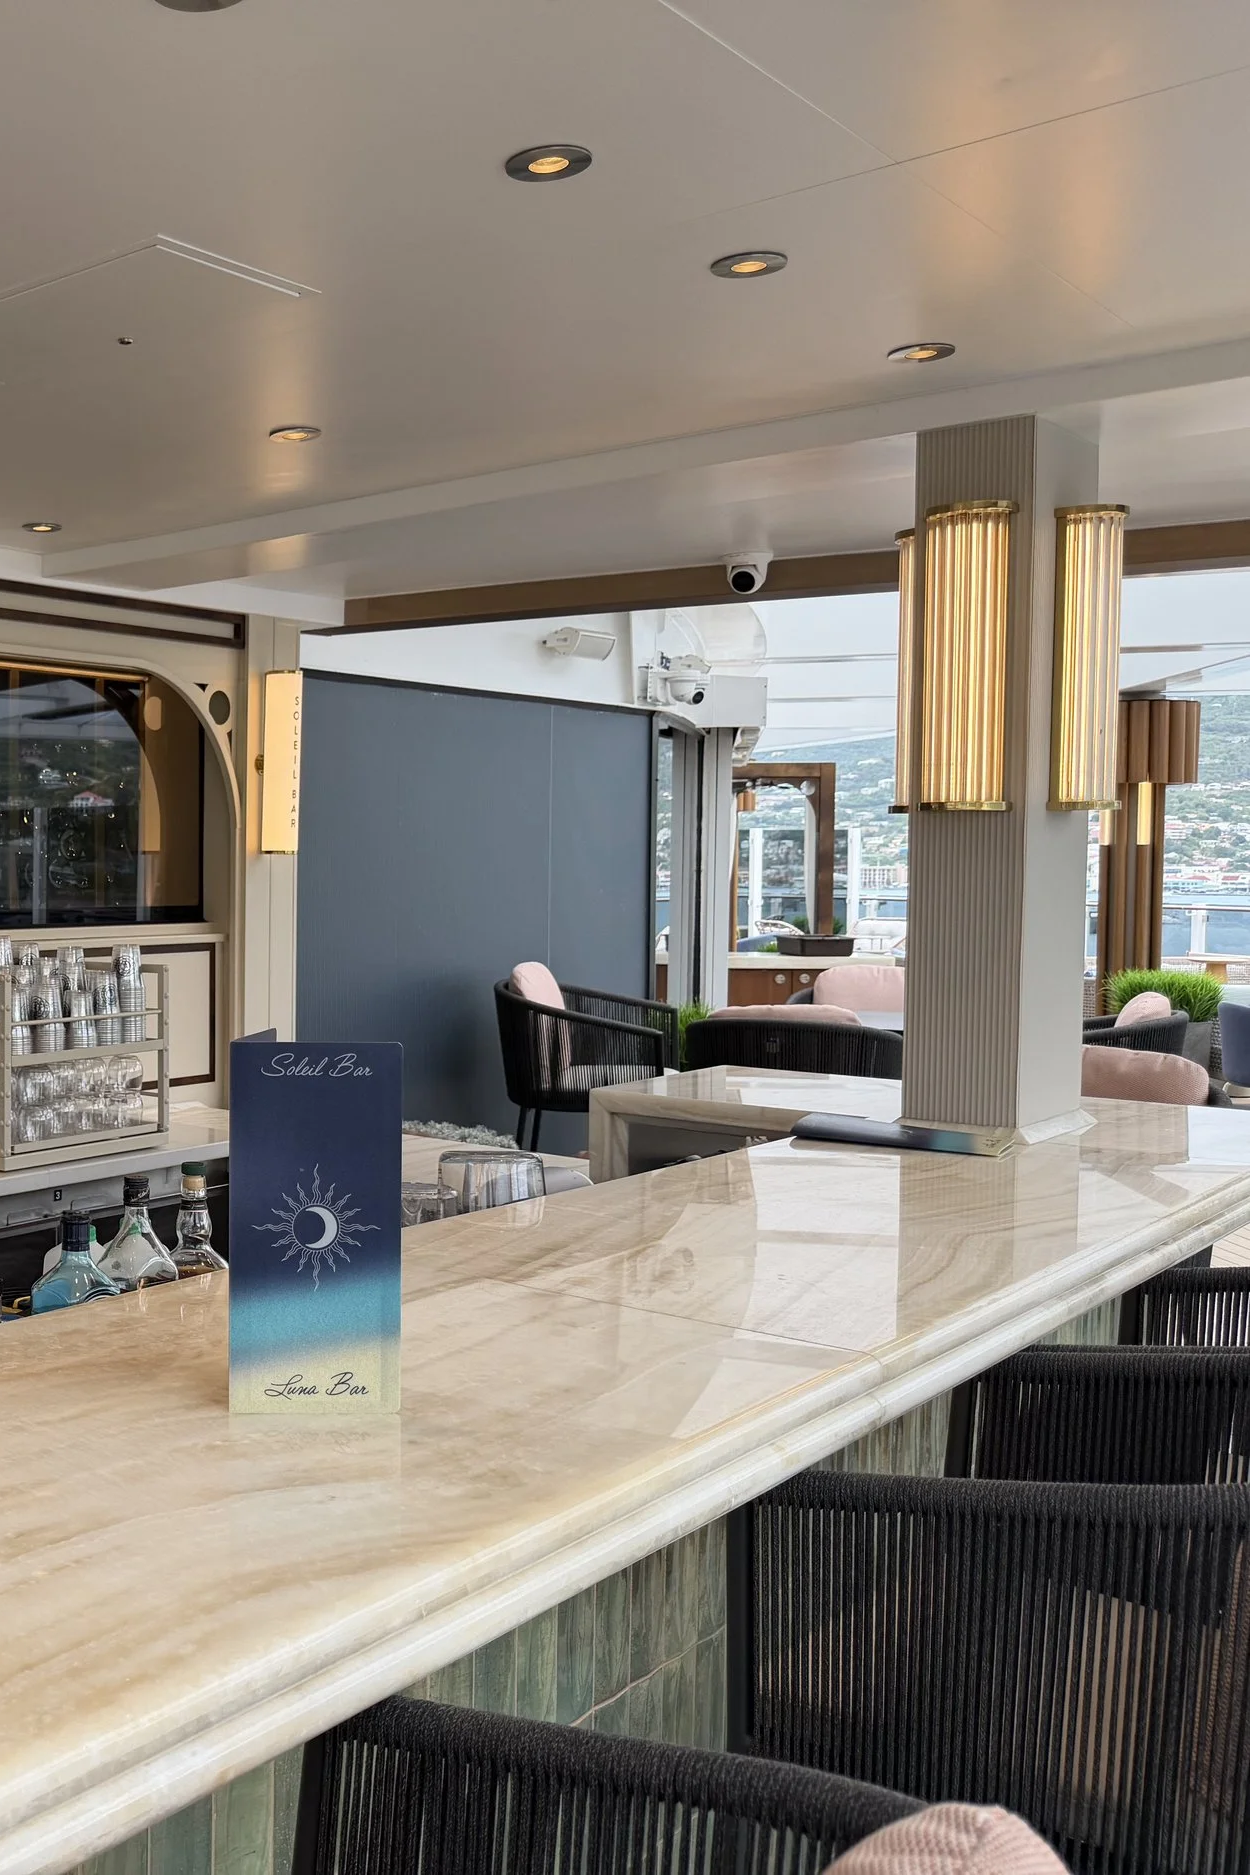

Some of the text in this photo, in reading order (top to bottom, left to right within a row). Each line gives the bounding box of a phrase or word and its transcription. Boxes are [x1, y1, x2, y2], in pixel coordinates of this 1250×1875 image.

[292, 696, 300, 780] SOLEIL
[260, 1052, 373, 1077] Soleil Bar
[55, 1191, 61, 1200] 3
[264, 1371, 369, 1400] Luna Bar
